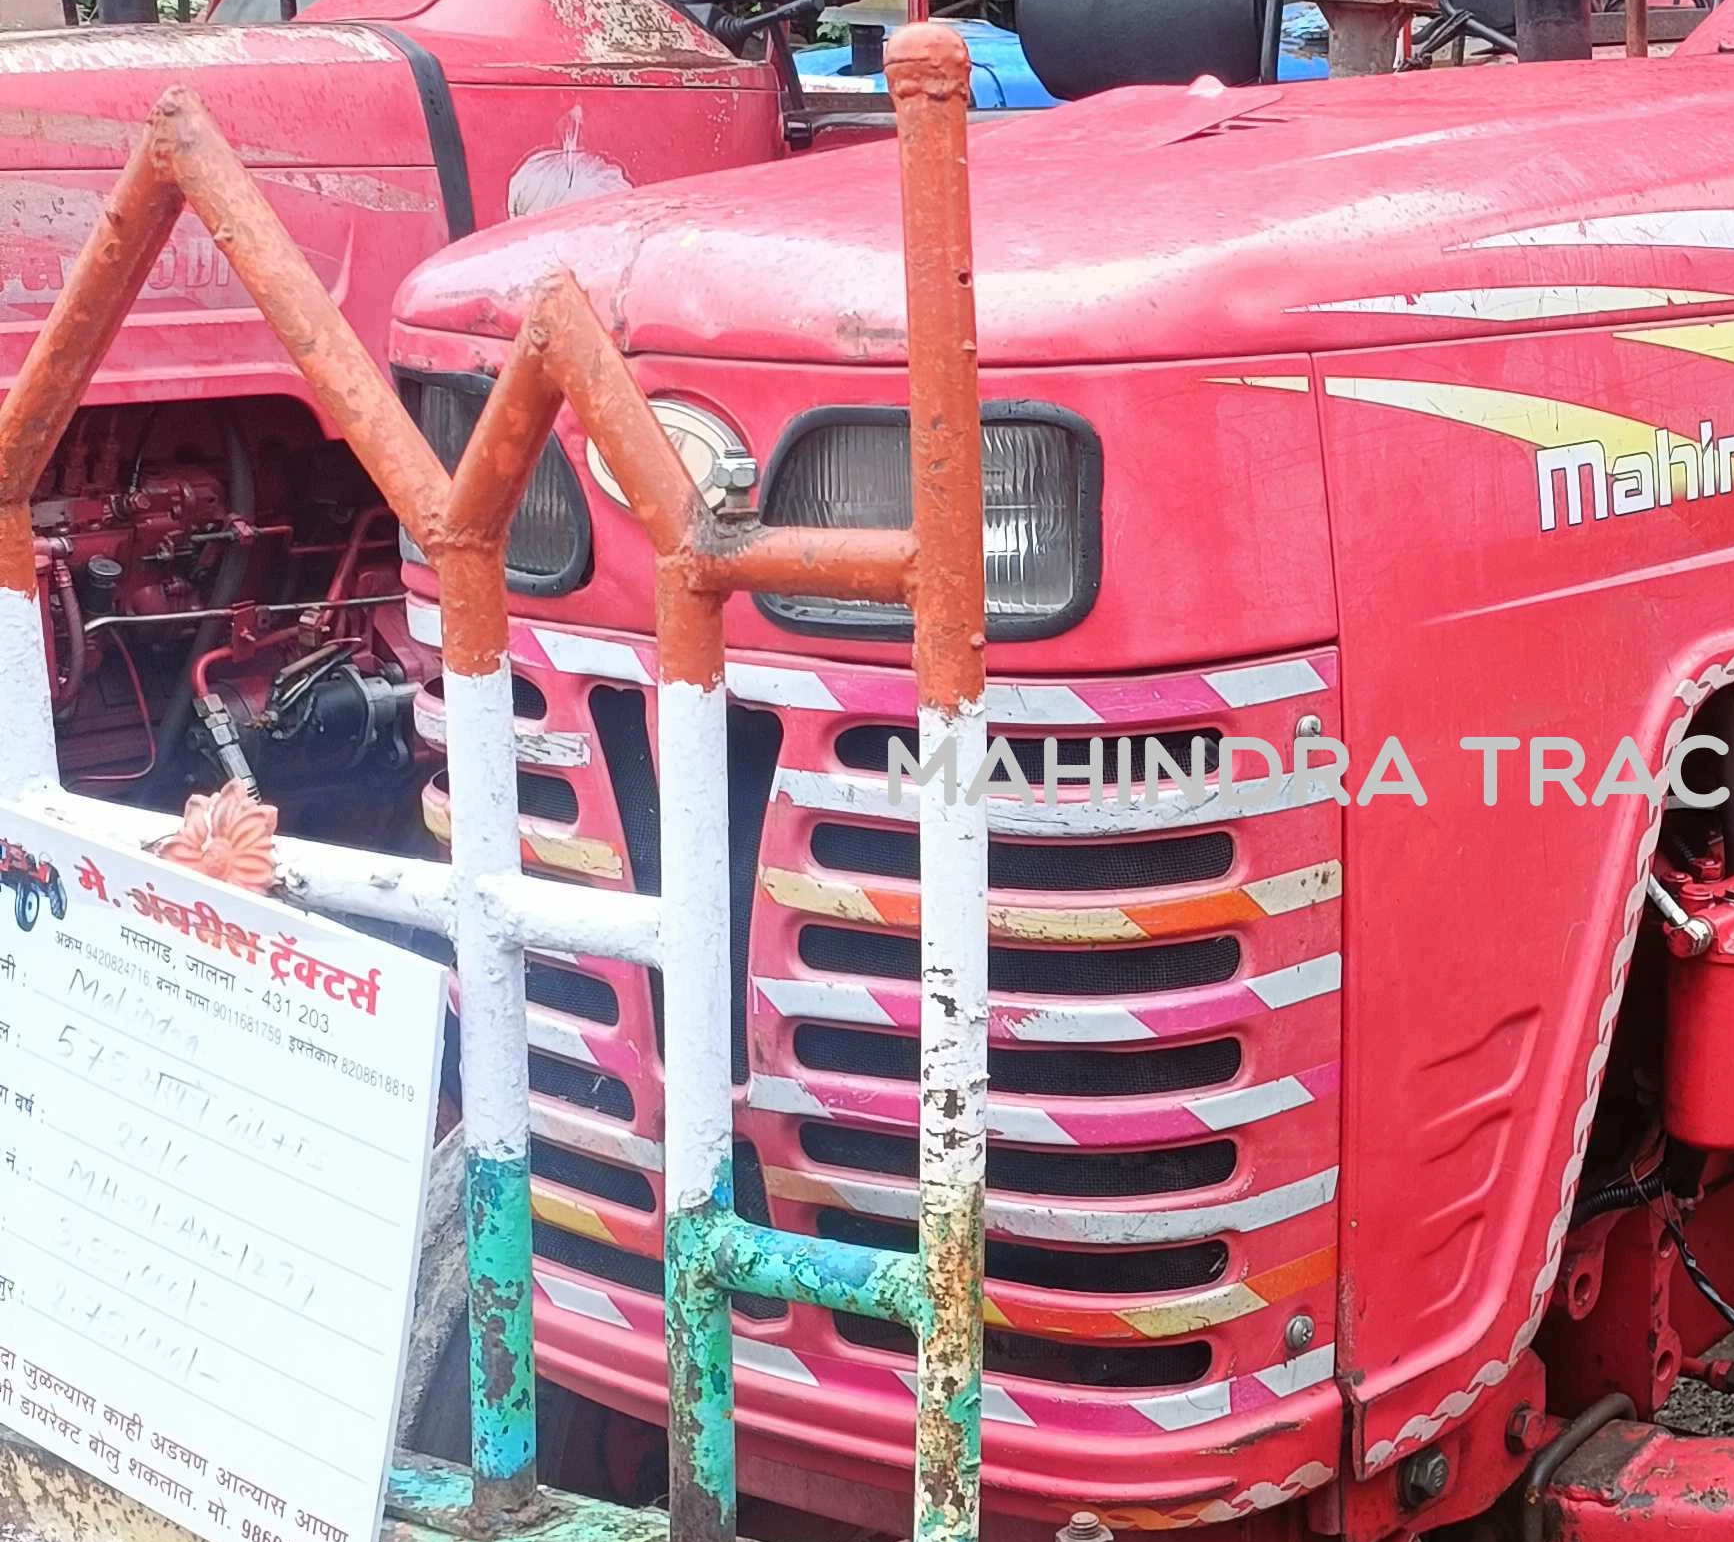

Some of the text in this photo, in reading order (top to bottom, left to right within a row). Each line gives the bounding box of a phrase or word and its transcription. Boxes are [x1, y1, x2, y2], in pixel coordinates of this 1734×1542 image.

[186, 954, 236, 992] जालना
[262, 990, 291, 1016] 431
[103, 1403, 144, 1442] काही
[150, 1431, 208, 1477] अडचण
[215, 1466, 288, 1519] आल्यास
